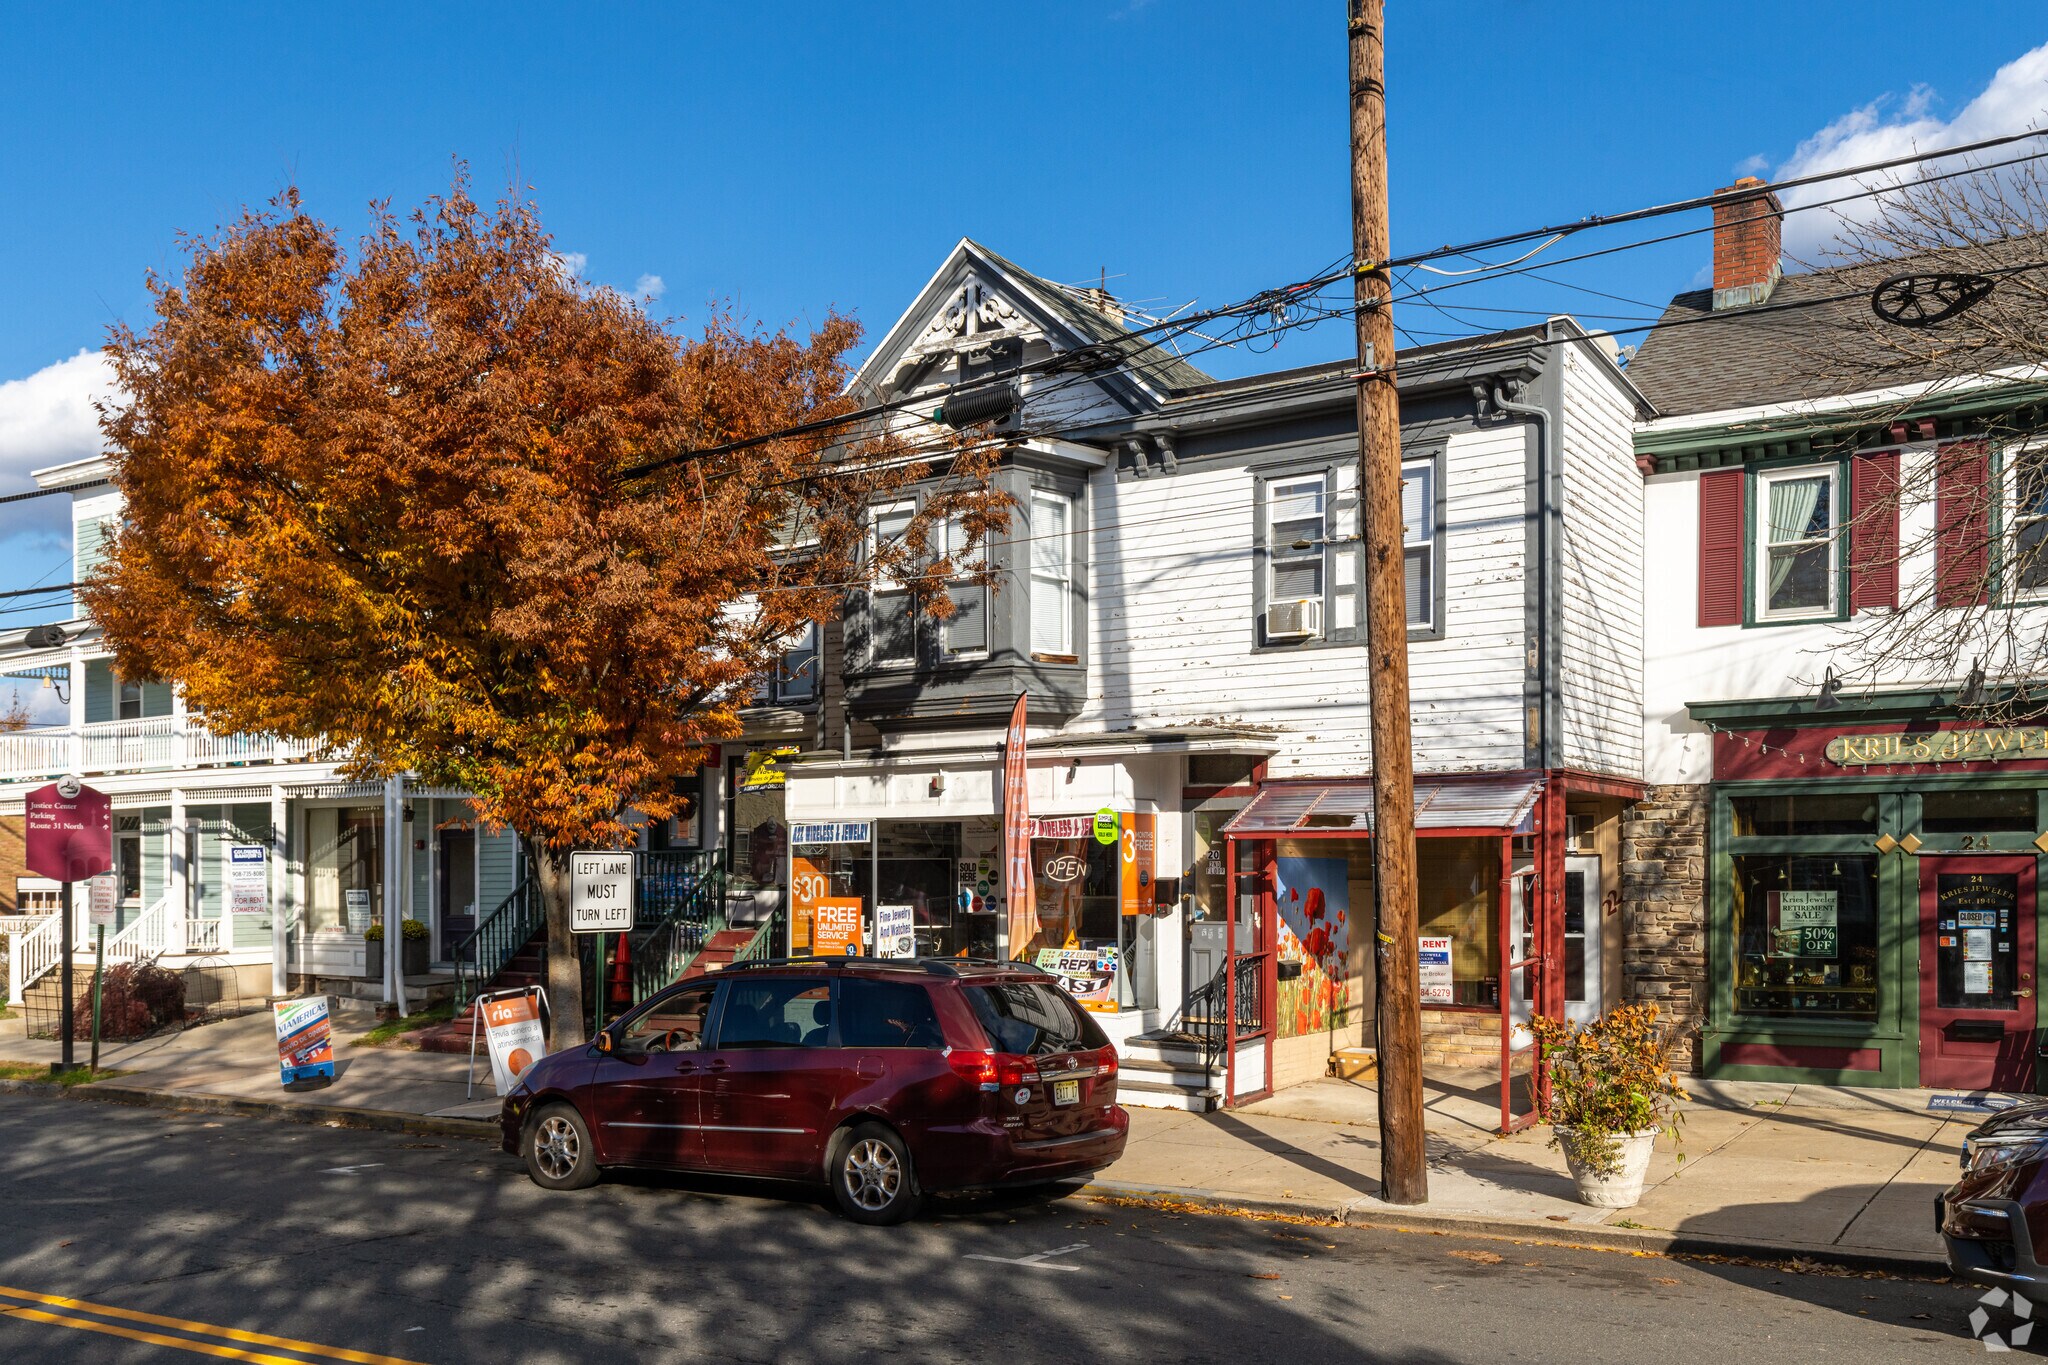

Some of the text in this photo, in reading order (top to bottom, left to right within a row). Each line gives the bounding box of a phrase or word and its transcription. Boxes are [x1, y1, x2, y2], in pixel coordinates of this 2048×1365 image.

[1843, 734, 1931, 760] KRIES
[30, 812, 56, 821] Parking
[792, 826, 804, 843] A2Z
[806, 824, 834, 842] WIRELESS
[842, 824, 868, 841] JEWELRY
[1038, 819, 1072, 837] WIRELESS
[1123, 829, 1135, 863] 3
[1135, 840, 1153, 850] FREE
[1961, 836, 1990, 850] 24
[1208, 851, 1219, 859] 20
[578, 862, 627, 875] LEFT LANE
[960, 862, 976, 872] SOLD
[1046, 860, 1087, 876] OPEN
[960, 872, 976, 882] HERE
[587, 884, 617, 899] MUST
[793, 876, 824, 902] $30
[1940, 886, 2015, 900] KRIES JEWELER
[1602, 890, 1624, 916] 22
[1782, 892, 1836, 904] Kries Jeweler
[577, 908, 627, 921] TURN LEFT
[818, 907, 857, 923] FREE
[880, 908, 910, 922] Fine Jewelry
[1960, 912, 1982, 921] CLOSED
[818, 923, 856, 931] UNLIMITED
[880, 922, 910, 938] And Watches
[1804, 928, 1835, 940] 50%
[818, 932, 848, 940] SERVICE
[1806, 941, 1832, 950] OFF
[1058, 959, 1097, 971] REPA
[1058, 976, 1108, 993] AST
[1420, 988, 1450, 996] 84-5279
[278, 1002, 326, 1033] VIAMERICAS
[492, 1004, 512, 1022] ria
[308, 1023, 329, 1038] DINERO
[511, 1025, 531, 1035] dinero
[497, 1034, 540, 1048] atinoamérica
